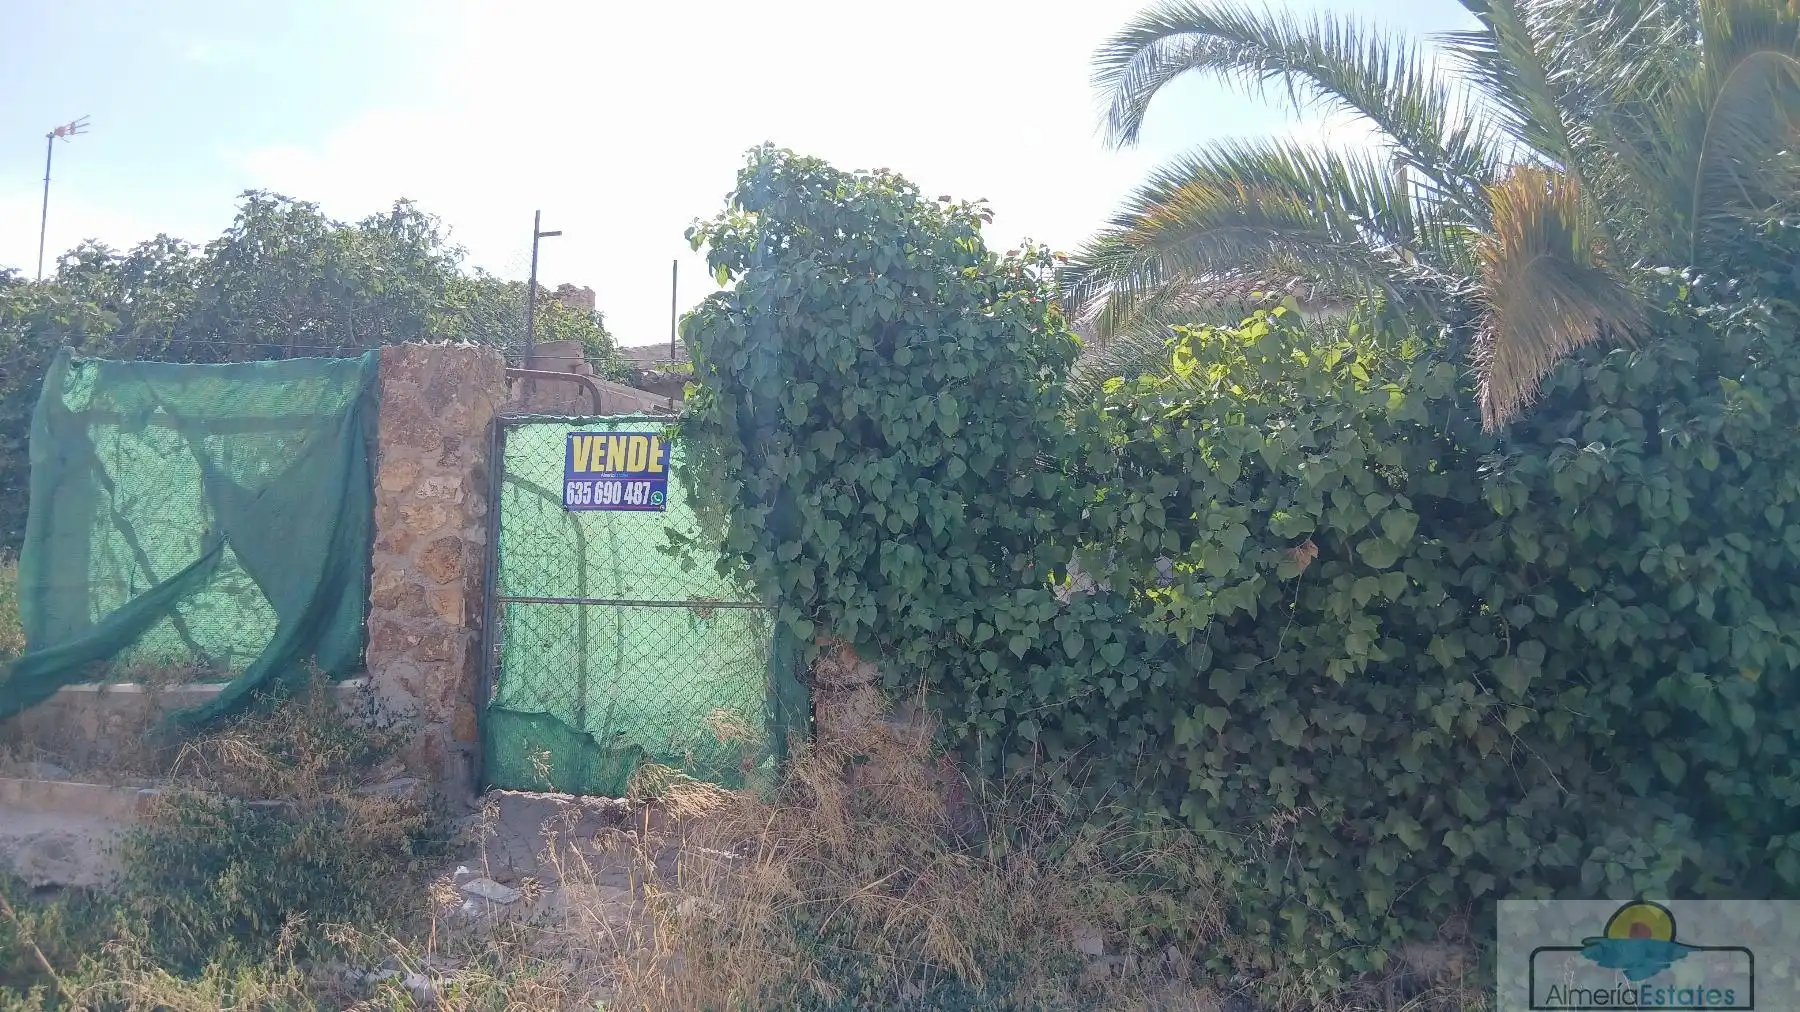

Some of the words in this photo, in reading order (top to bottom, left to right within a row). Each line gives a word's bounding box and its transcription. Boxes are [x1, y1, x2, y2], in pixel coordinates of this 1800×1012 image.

[573, 435, 664, 473] VENDE
[566, 481, 592, 505] 635
[594, 481, 622, 505] 690
[624, 481, 651, 505] 487
